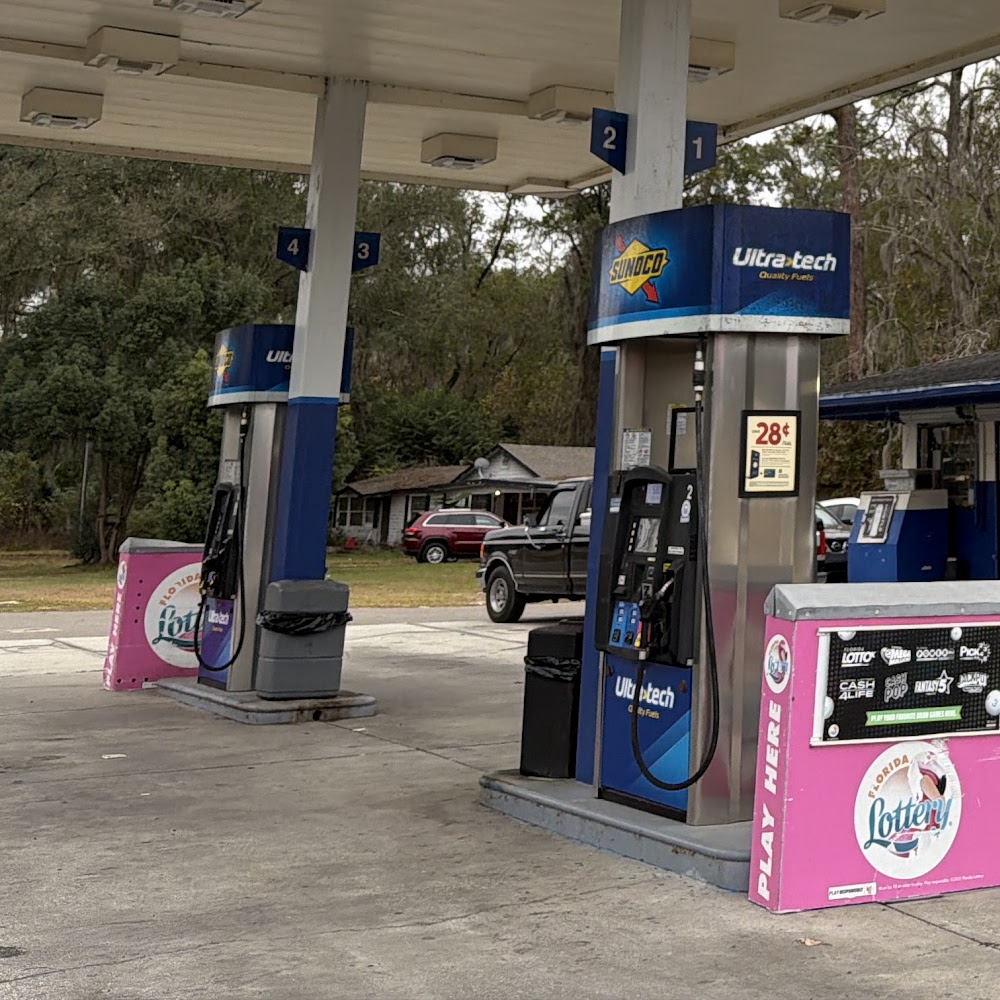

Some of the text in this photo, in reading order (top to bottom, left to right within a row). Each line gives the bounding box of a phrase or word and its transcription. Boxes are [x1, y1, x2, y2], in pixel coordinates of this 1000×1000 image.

[602, 126, 617, 150] 2
[692, 136, 703, 160] 1
[287, 238, 300, 256] 4
[357, 242, 370, 260] 3
[609, 251, 665, 284] SUNOCO
[758, 270, 814, 281] Quality Fuels
[686, 484, 693, 500] 2
[839, 680, 876, 691] CASH
[883, 685, 909, 703] POP
[914, 679, 939, 694] FANTASY
[838, 690, 874, 701] 4LIFE
[870, 714, 882, 722] PLAY
[764, 699, 782, 794] HERE
[867, 753, 910, 799] FLORIDA
[863, 794, 952, 851] Lottery
[757, 803, 775, 900] PLAY
